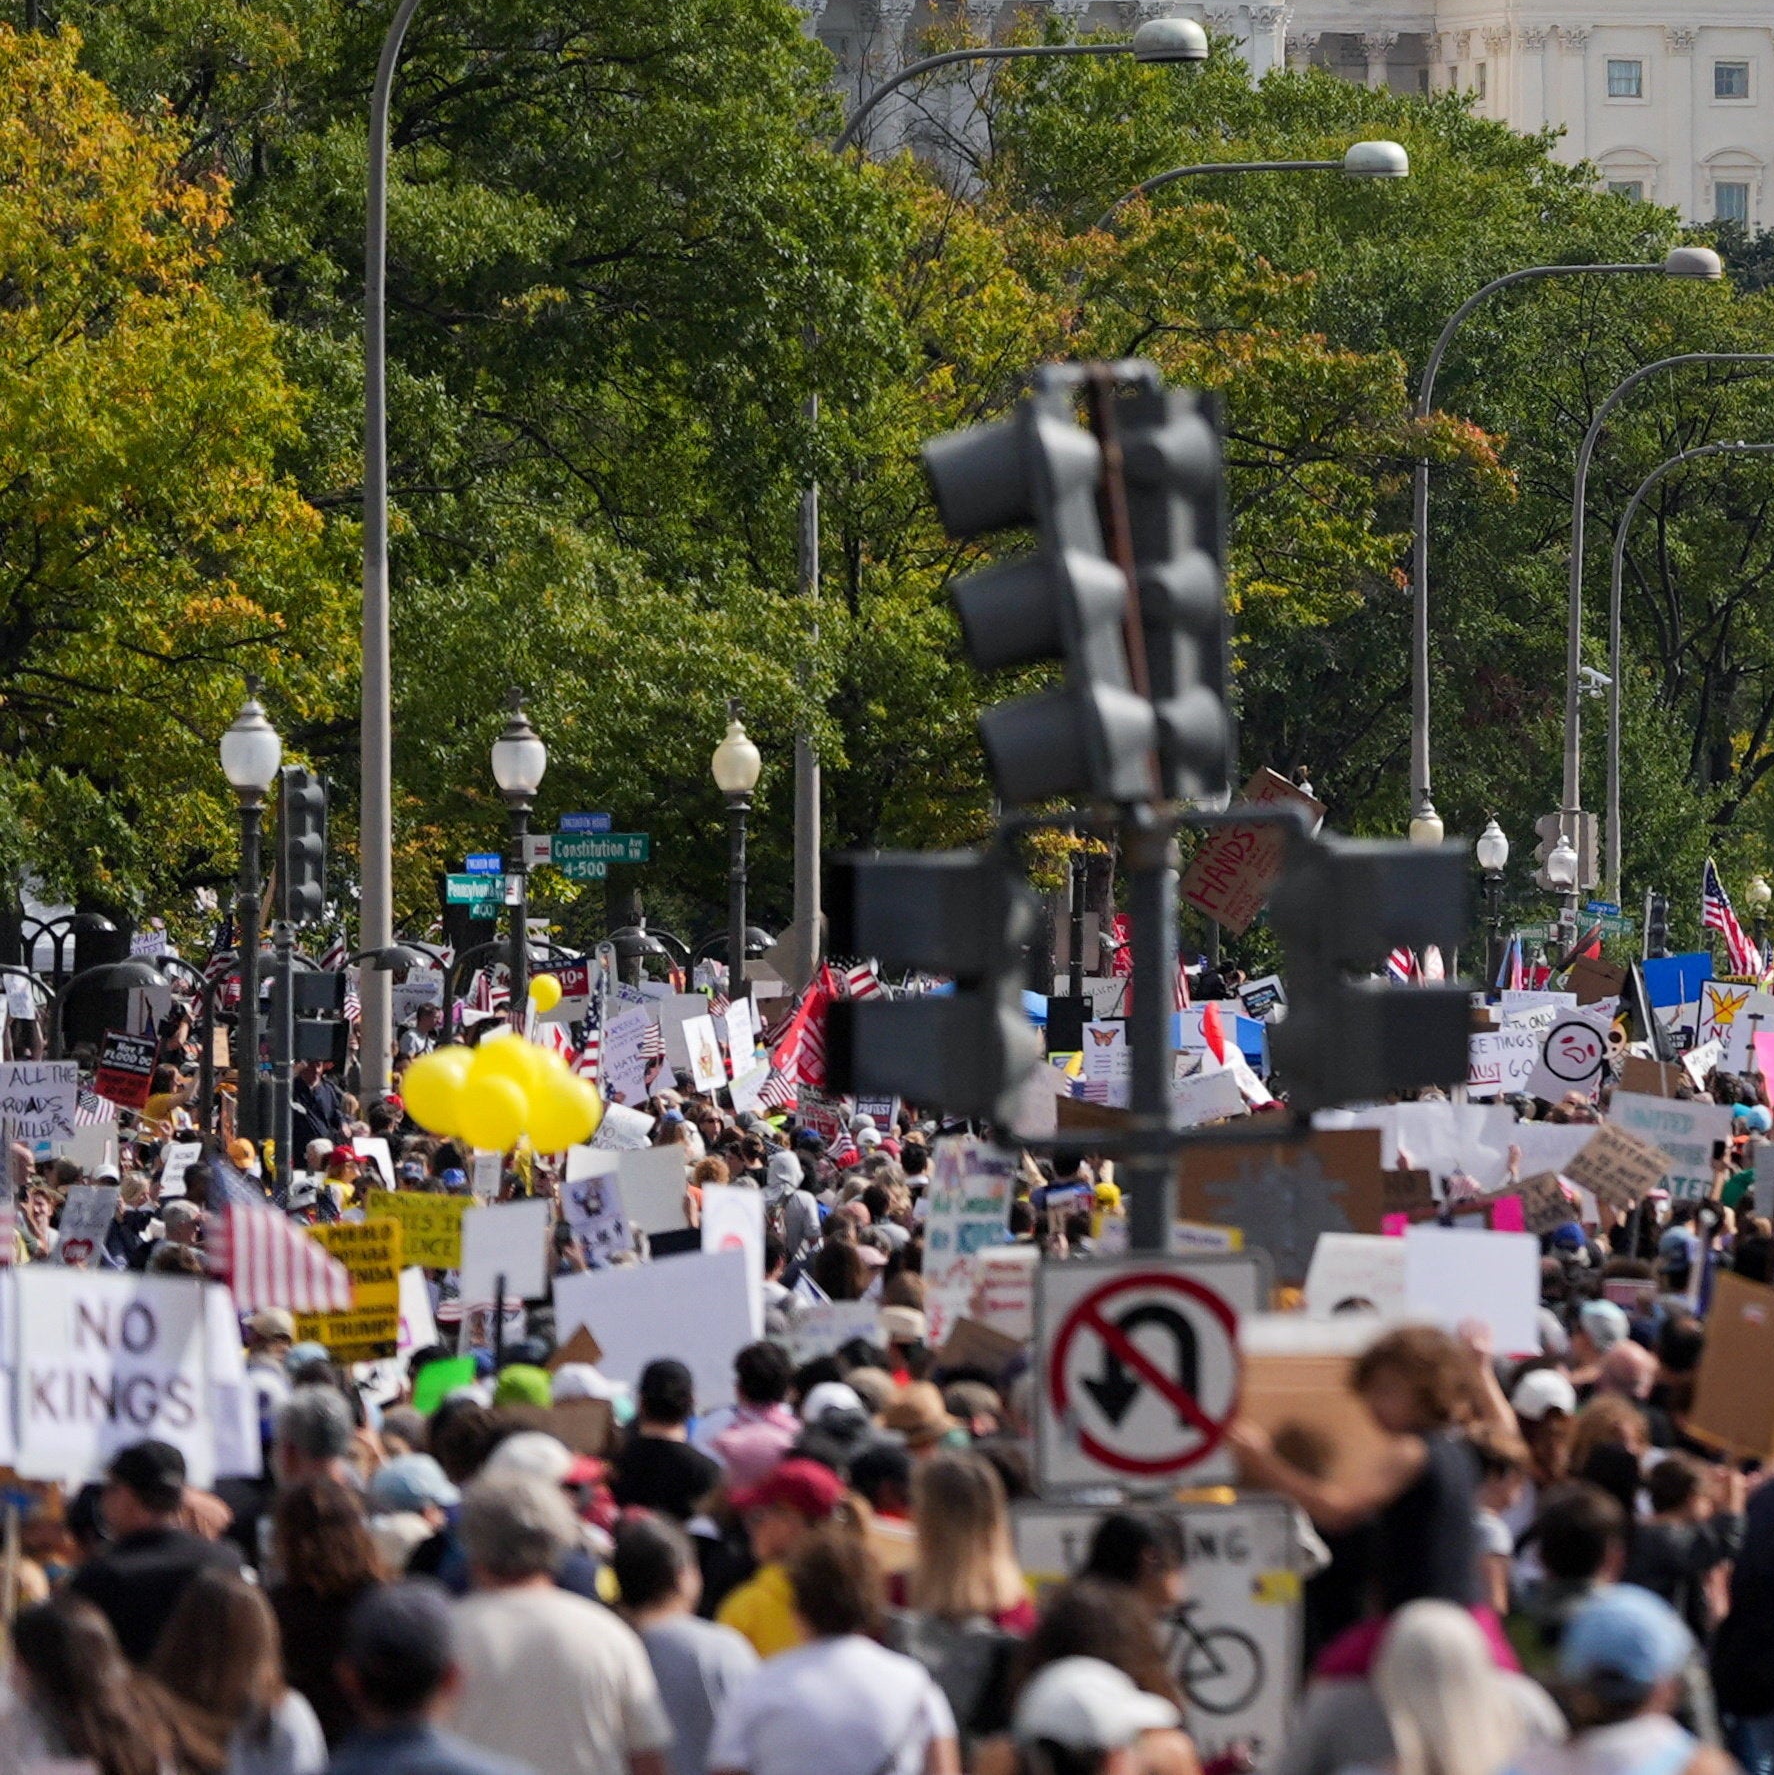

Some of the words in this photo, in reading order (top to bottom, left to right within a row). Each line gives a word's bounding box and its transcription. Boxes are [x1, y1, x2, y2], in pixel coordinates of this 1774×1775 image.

[554, 841, 625, 858] Constitution
[472, 904, 493, 917] 400
[103, 1049, 138, 1064] FLOOD
[9, 1067, 48, 1088] ALL
[51, 1064, 77, 1084] THE
[1508, 1059, 1535, 1077] GO
[857, 1103, 891, 1116] PROTEST
[75, 1299, 158, 1354] NO
[29, 1374, 196, 1425] KINGS
